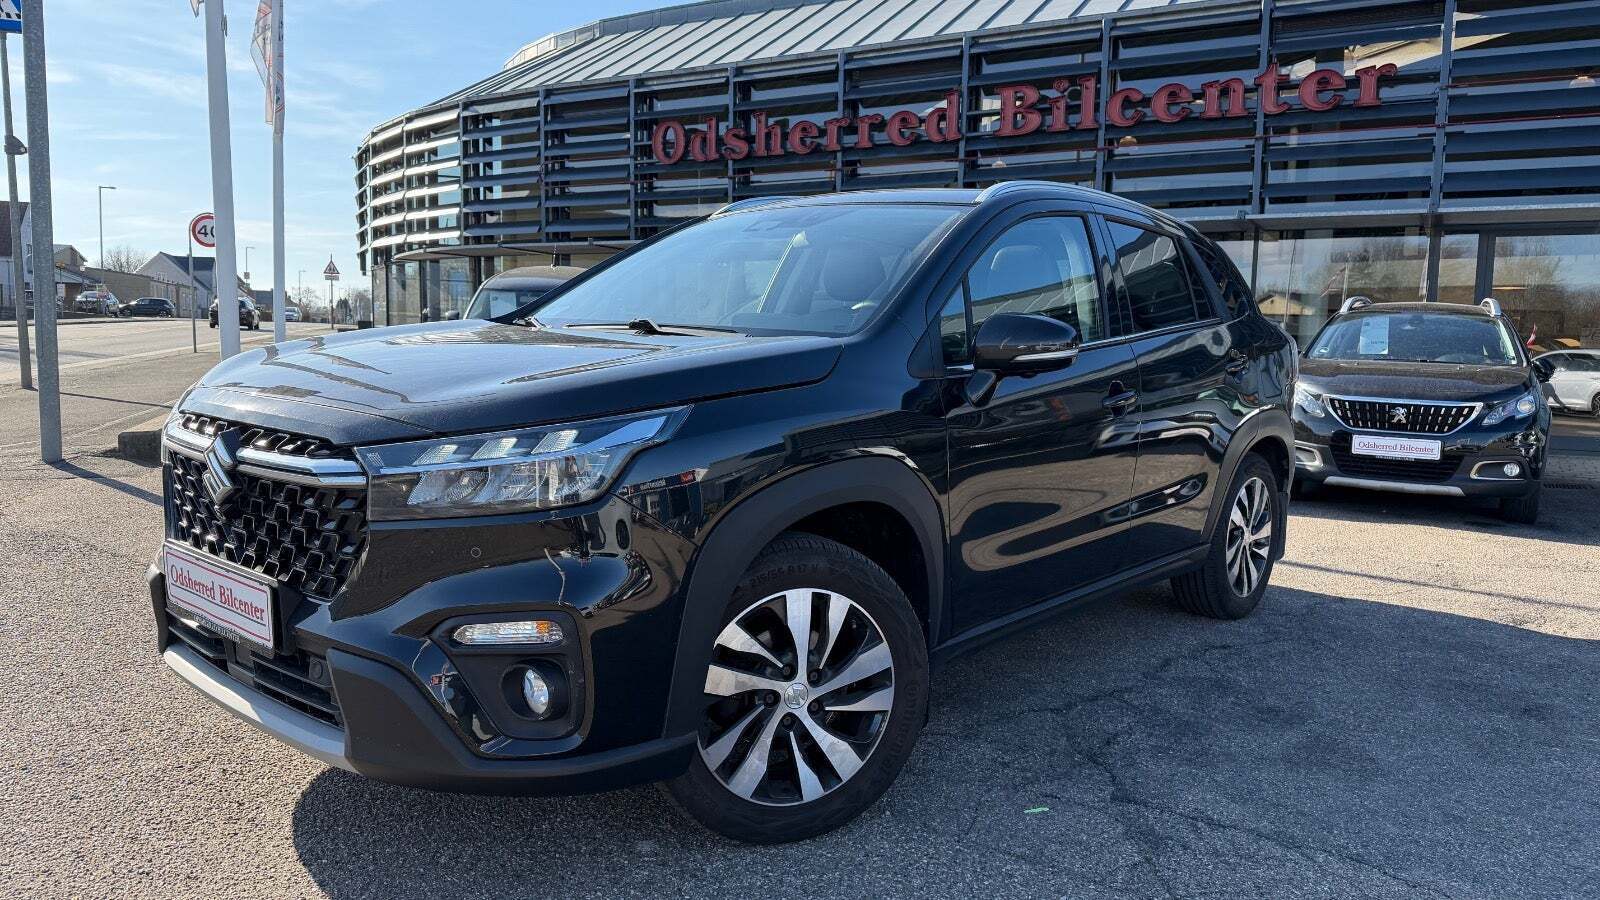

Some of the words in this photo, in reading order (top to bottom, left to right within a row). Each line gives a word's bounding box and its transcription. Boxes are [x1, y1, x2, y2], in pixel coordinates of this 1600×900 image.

[652, 89, 962, 164] Odsherred
[994, 61, 1398, 137] Bilcenter
[1358, 441, 1397, 451] Odsherred
[1399, 444, 1434, 454] Bilcenter
[170, 564, 216, 600] Odsherred
[218, 583, 265, 621] Bilcenter
